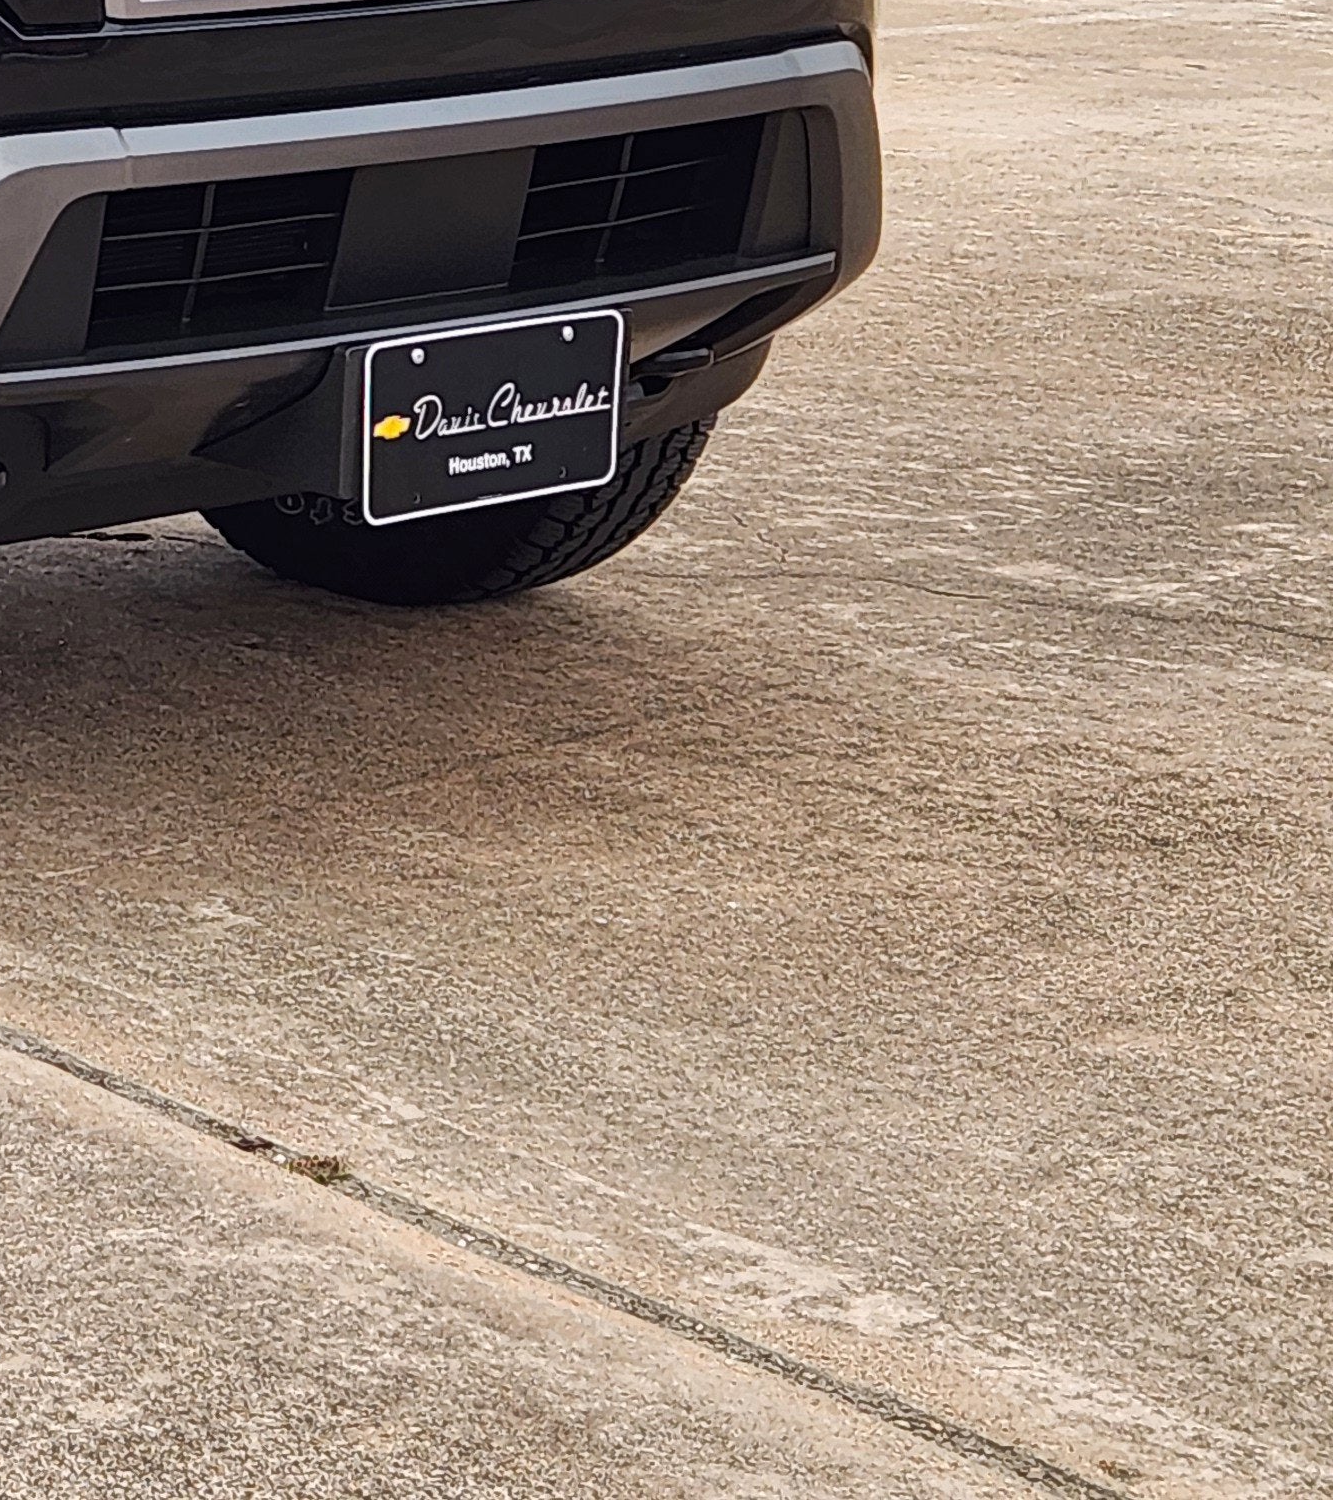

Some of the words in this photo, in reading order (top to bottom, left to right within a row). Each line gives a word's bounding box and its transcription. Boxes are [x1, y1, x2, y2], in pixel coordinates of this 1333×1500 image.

[413, 394, 487, 440] Davis
[487, 382, 612, 428] Chevrolet
[448, 450, 511, 476] Houston,
[512, 443, 533, 463] TX
